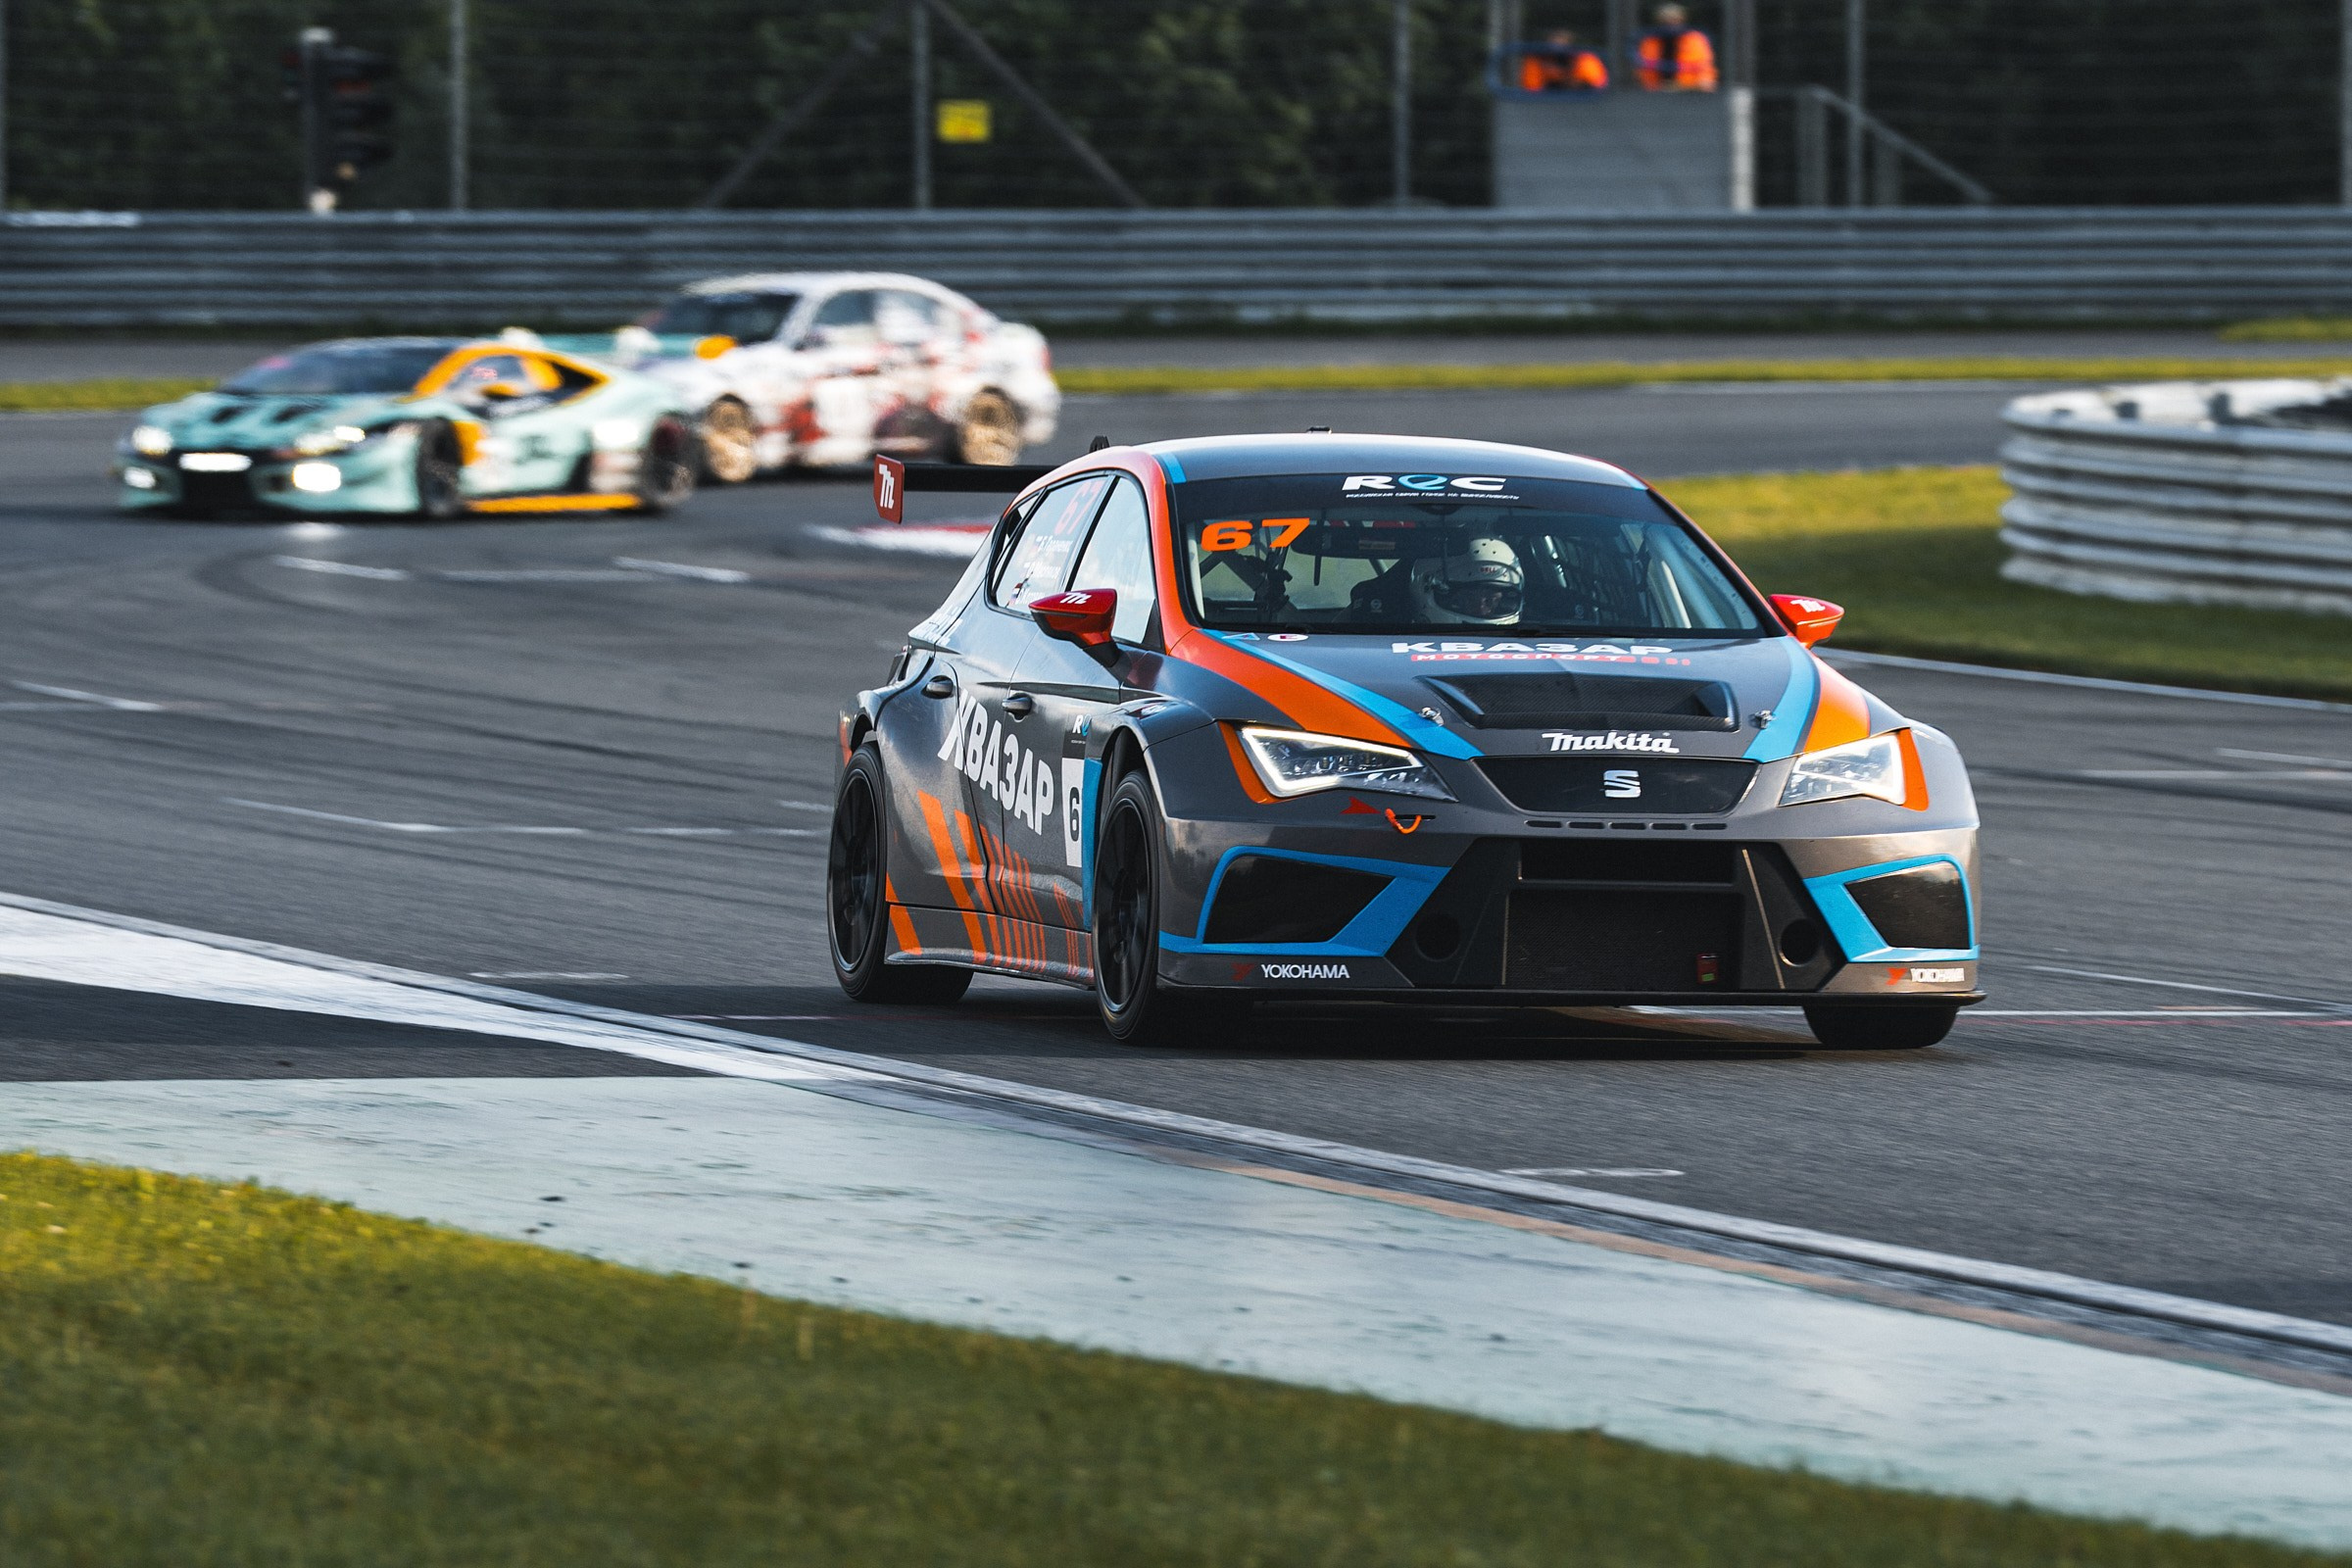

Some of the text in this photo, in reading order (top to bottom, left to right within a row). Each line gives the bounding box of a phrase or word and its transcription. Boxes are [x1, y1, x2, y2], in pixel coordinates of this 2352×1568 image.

[1200, 517, 1310, 553] 67
[1392, 642, 1673, 656] КВАЗАР
[1416, 654, 1626, 662] МОТОСПОРТ
[937, 688, 1054, 836] КВАЗАР
[1260, 964, 1350, 978] YOKOHAMA
